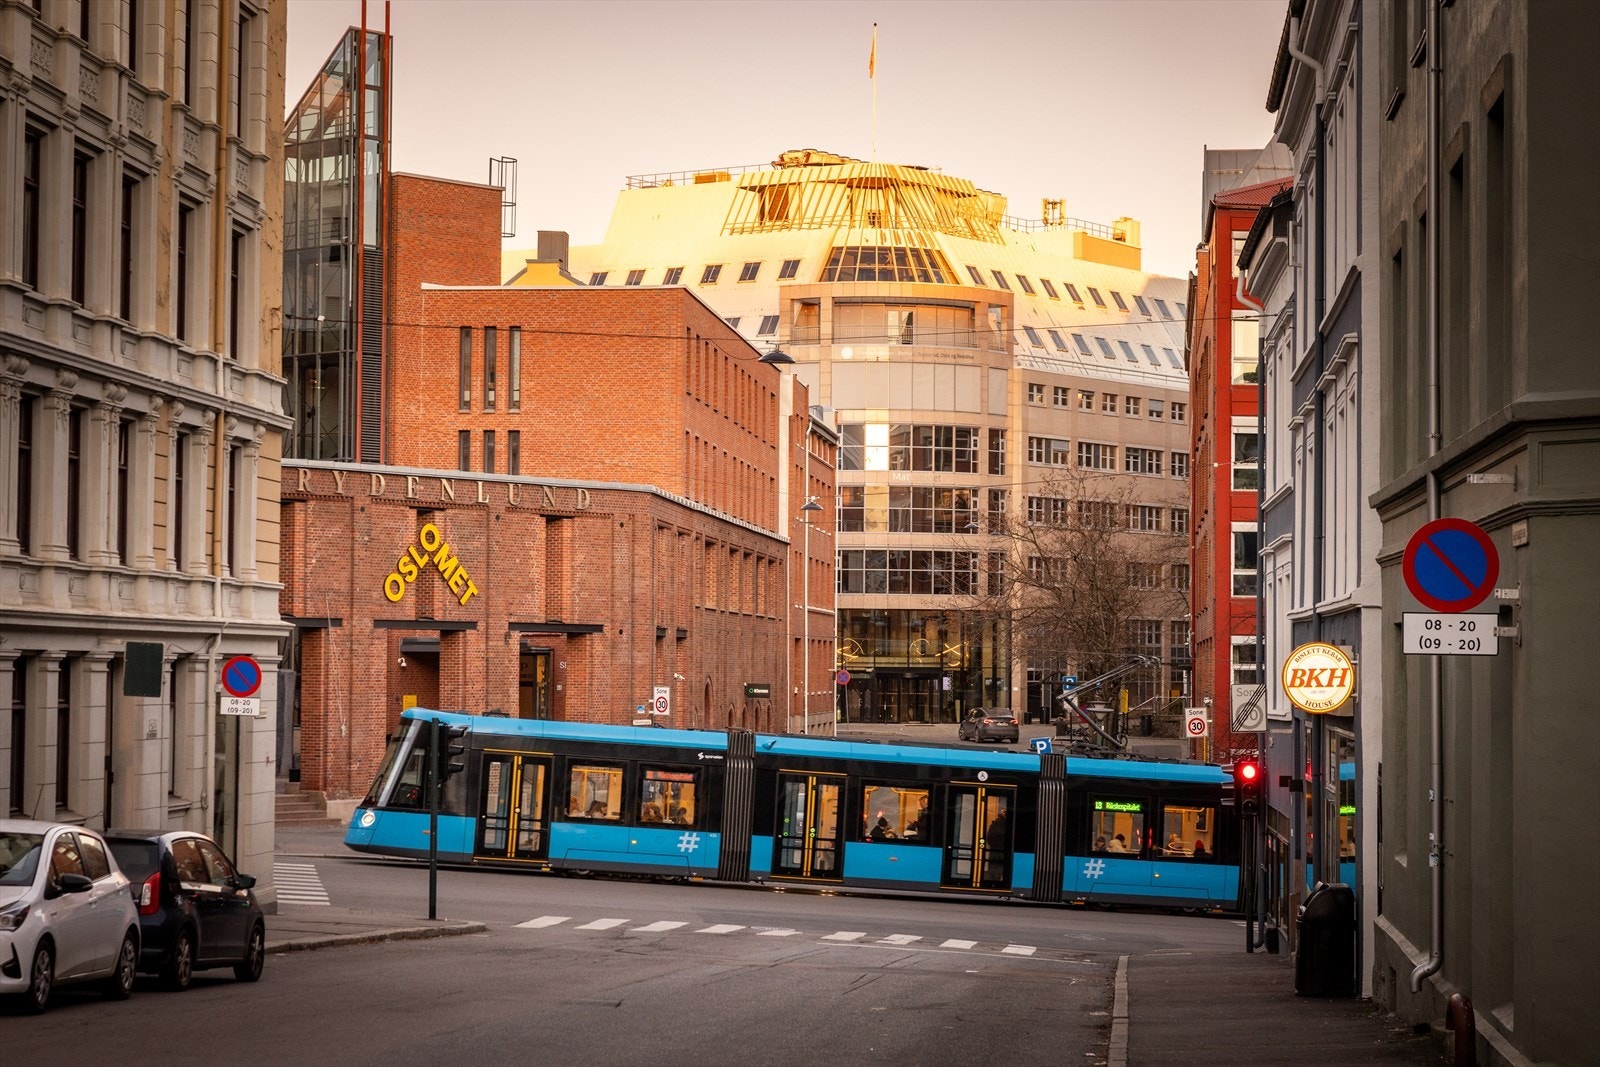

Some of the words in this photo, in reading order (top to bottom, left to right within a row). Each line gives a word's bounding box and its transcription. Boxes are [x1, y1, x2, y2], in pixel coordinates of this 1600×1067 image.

[296, 468, 591, 510] RYDENLUND
[1425, 619, 1442, 630] 08
[1459, 621, 1476, 631] 20
[1294, 648, 1321, 663] BISLETT
[1322, 648, 1343, 663] KEBAB
[1287, 667, 1350, 688] BKH
[1236, 687, 1258, 697] Son
[658, 700, 666, 709] 30
[1304, 699, 1335, 709] HOUSE
[1191, 722, 1203, 731] 30
[1036, 740, 1048, 755] P
